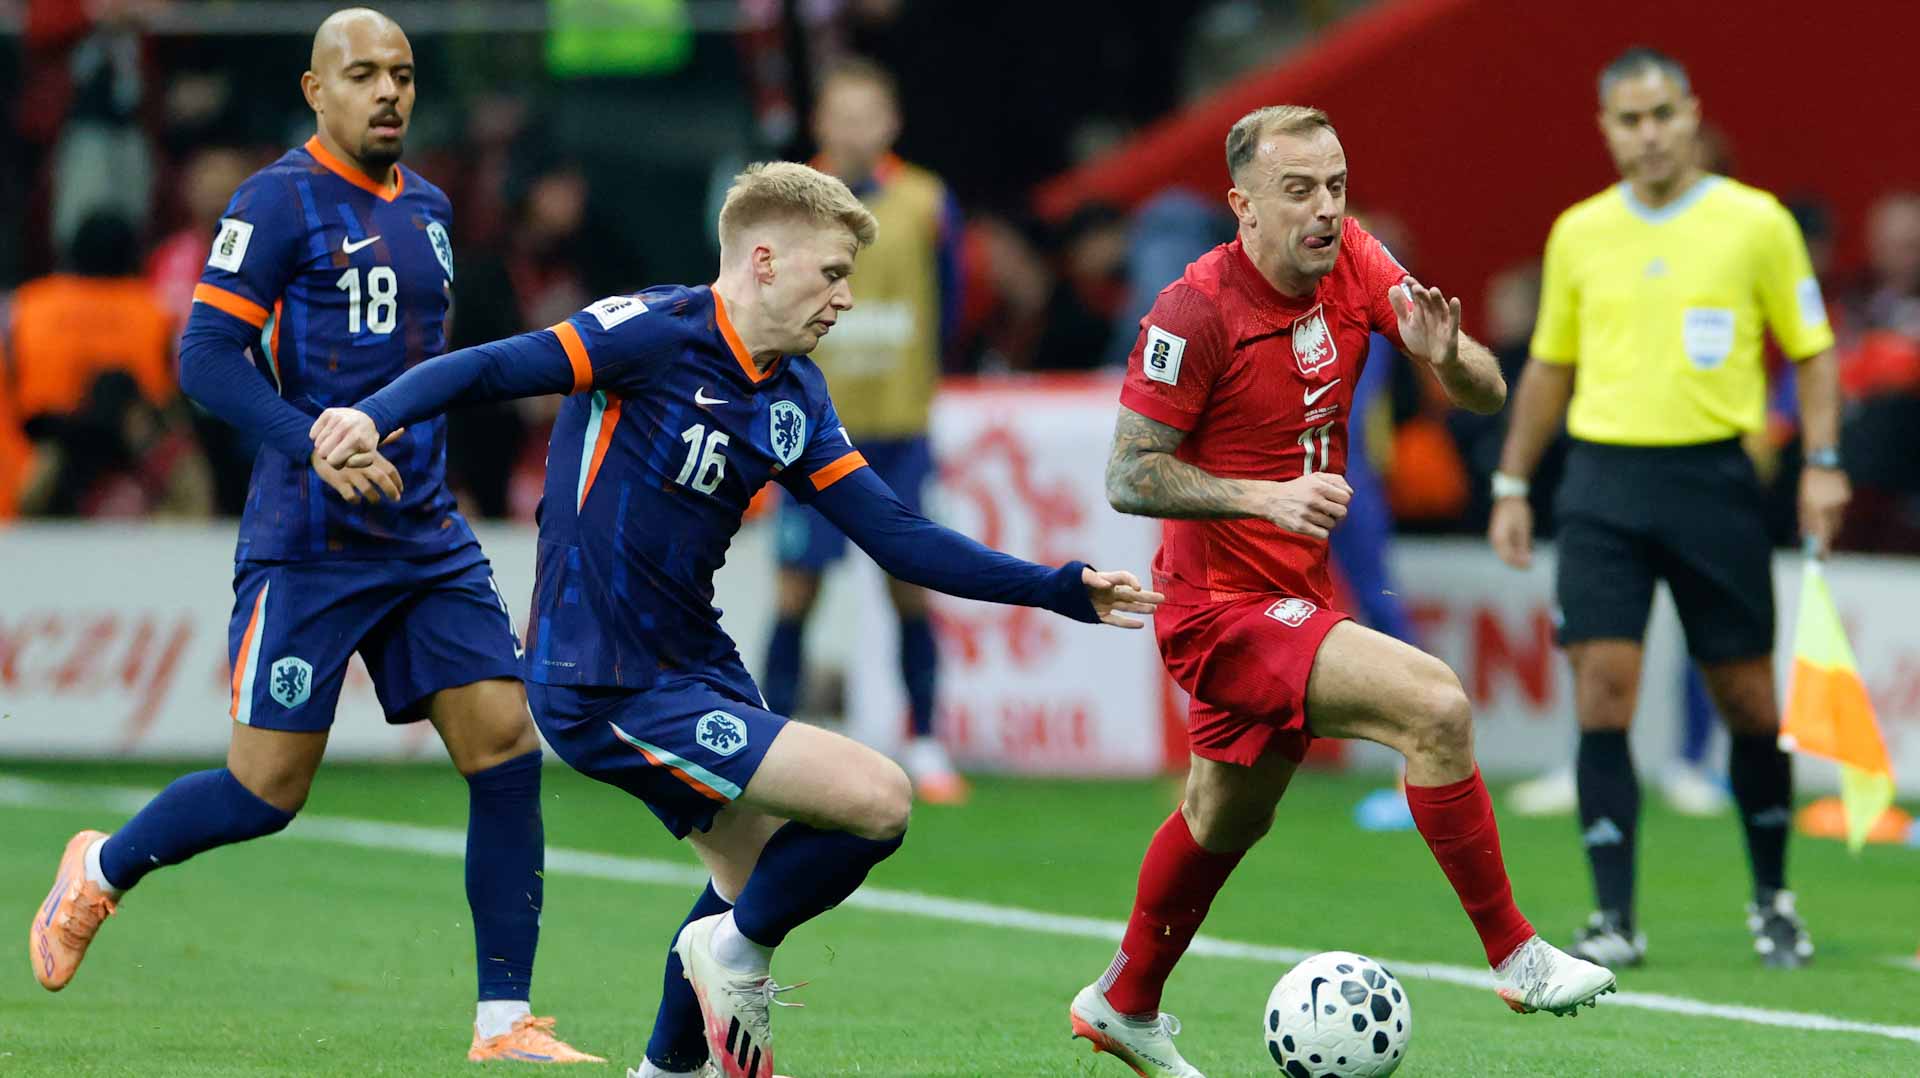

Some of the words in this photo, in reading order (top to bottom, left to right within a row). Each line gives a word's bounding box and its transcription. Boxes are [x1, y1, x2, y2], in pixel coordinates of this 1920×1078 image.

[336, 266, 398, 334] 18
[675, 423, 730, 495] 16
[1298, 420, 1335, 477] 11
